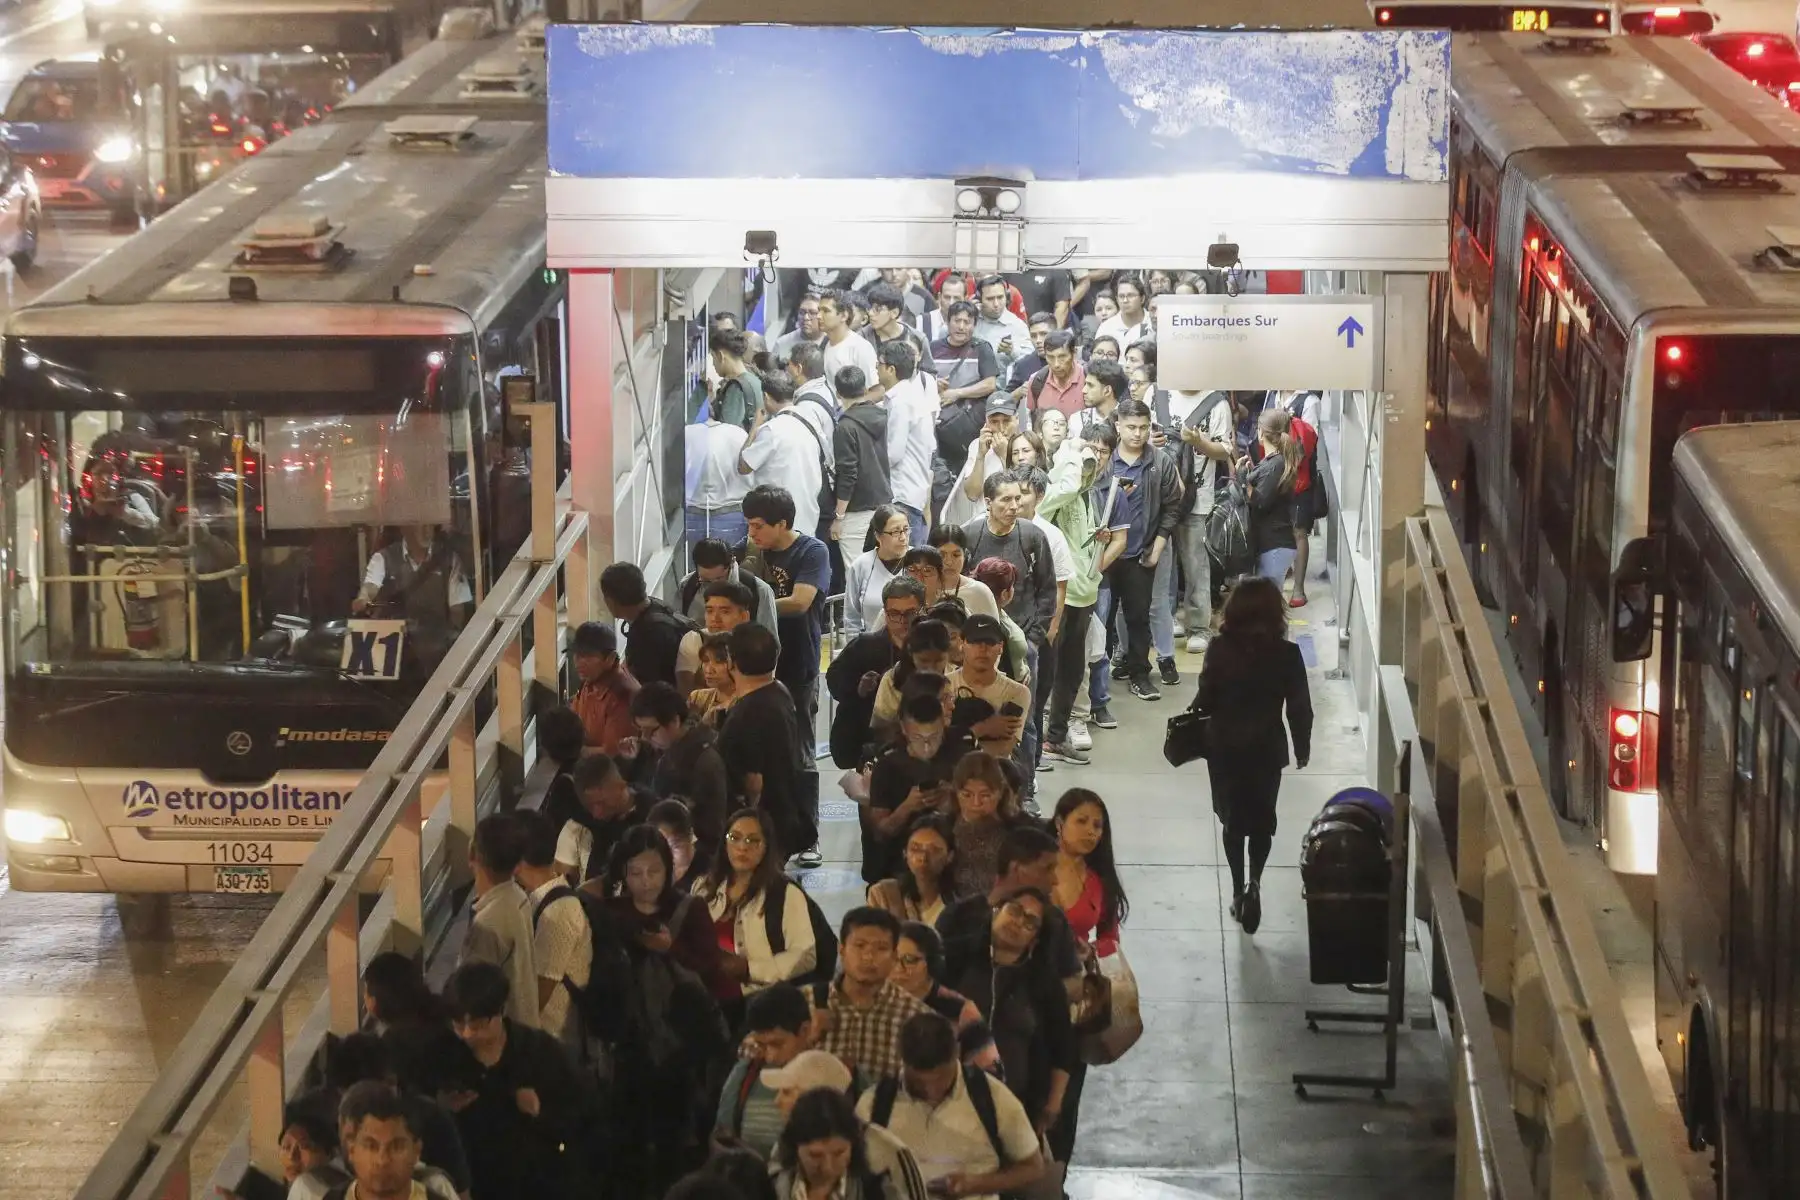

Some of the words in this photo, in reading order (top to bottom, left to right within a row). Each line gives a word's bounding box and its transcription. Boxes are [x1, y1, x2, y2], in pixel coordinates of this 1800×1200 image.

[1172, 315, 1251, 328] Embarques
[1255, 315, 1278, 326] Sur
[347, 632, 400, 676] X1
[287, 728, 393, 741] modasa
[173, 814, 281, 826] MUNICIPALIDAD
[287, 815, 308, 826] DE
[207, 843, 273, 862] 11034
